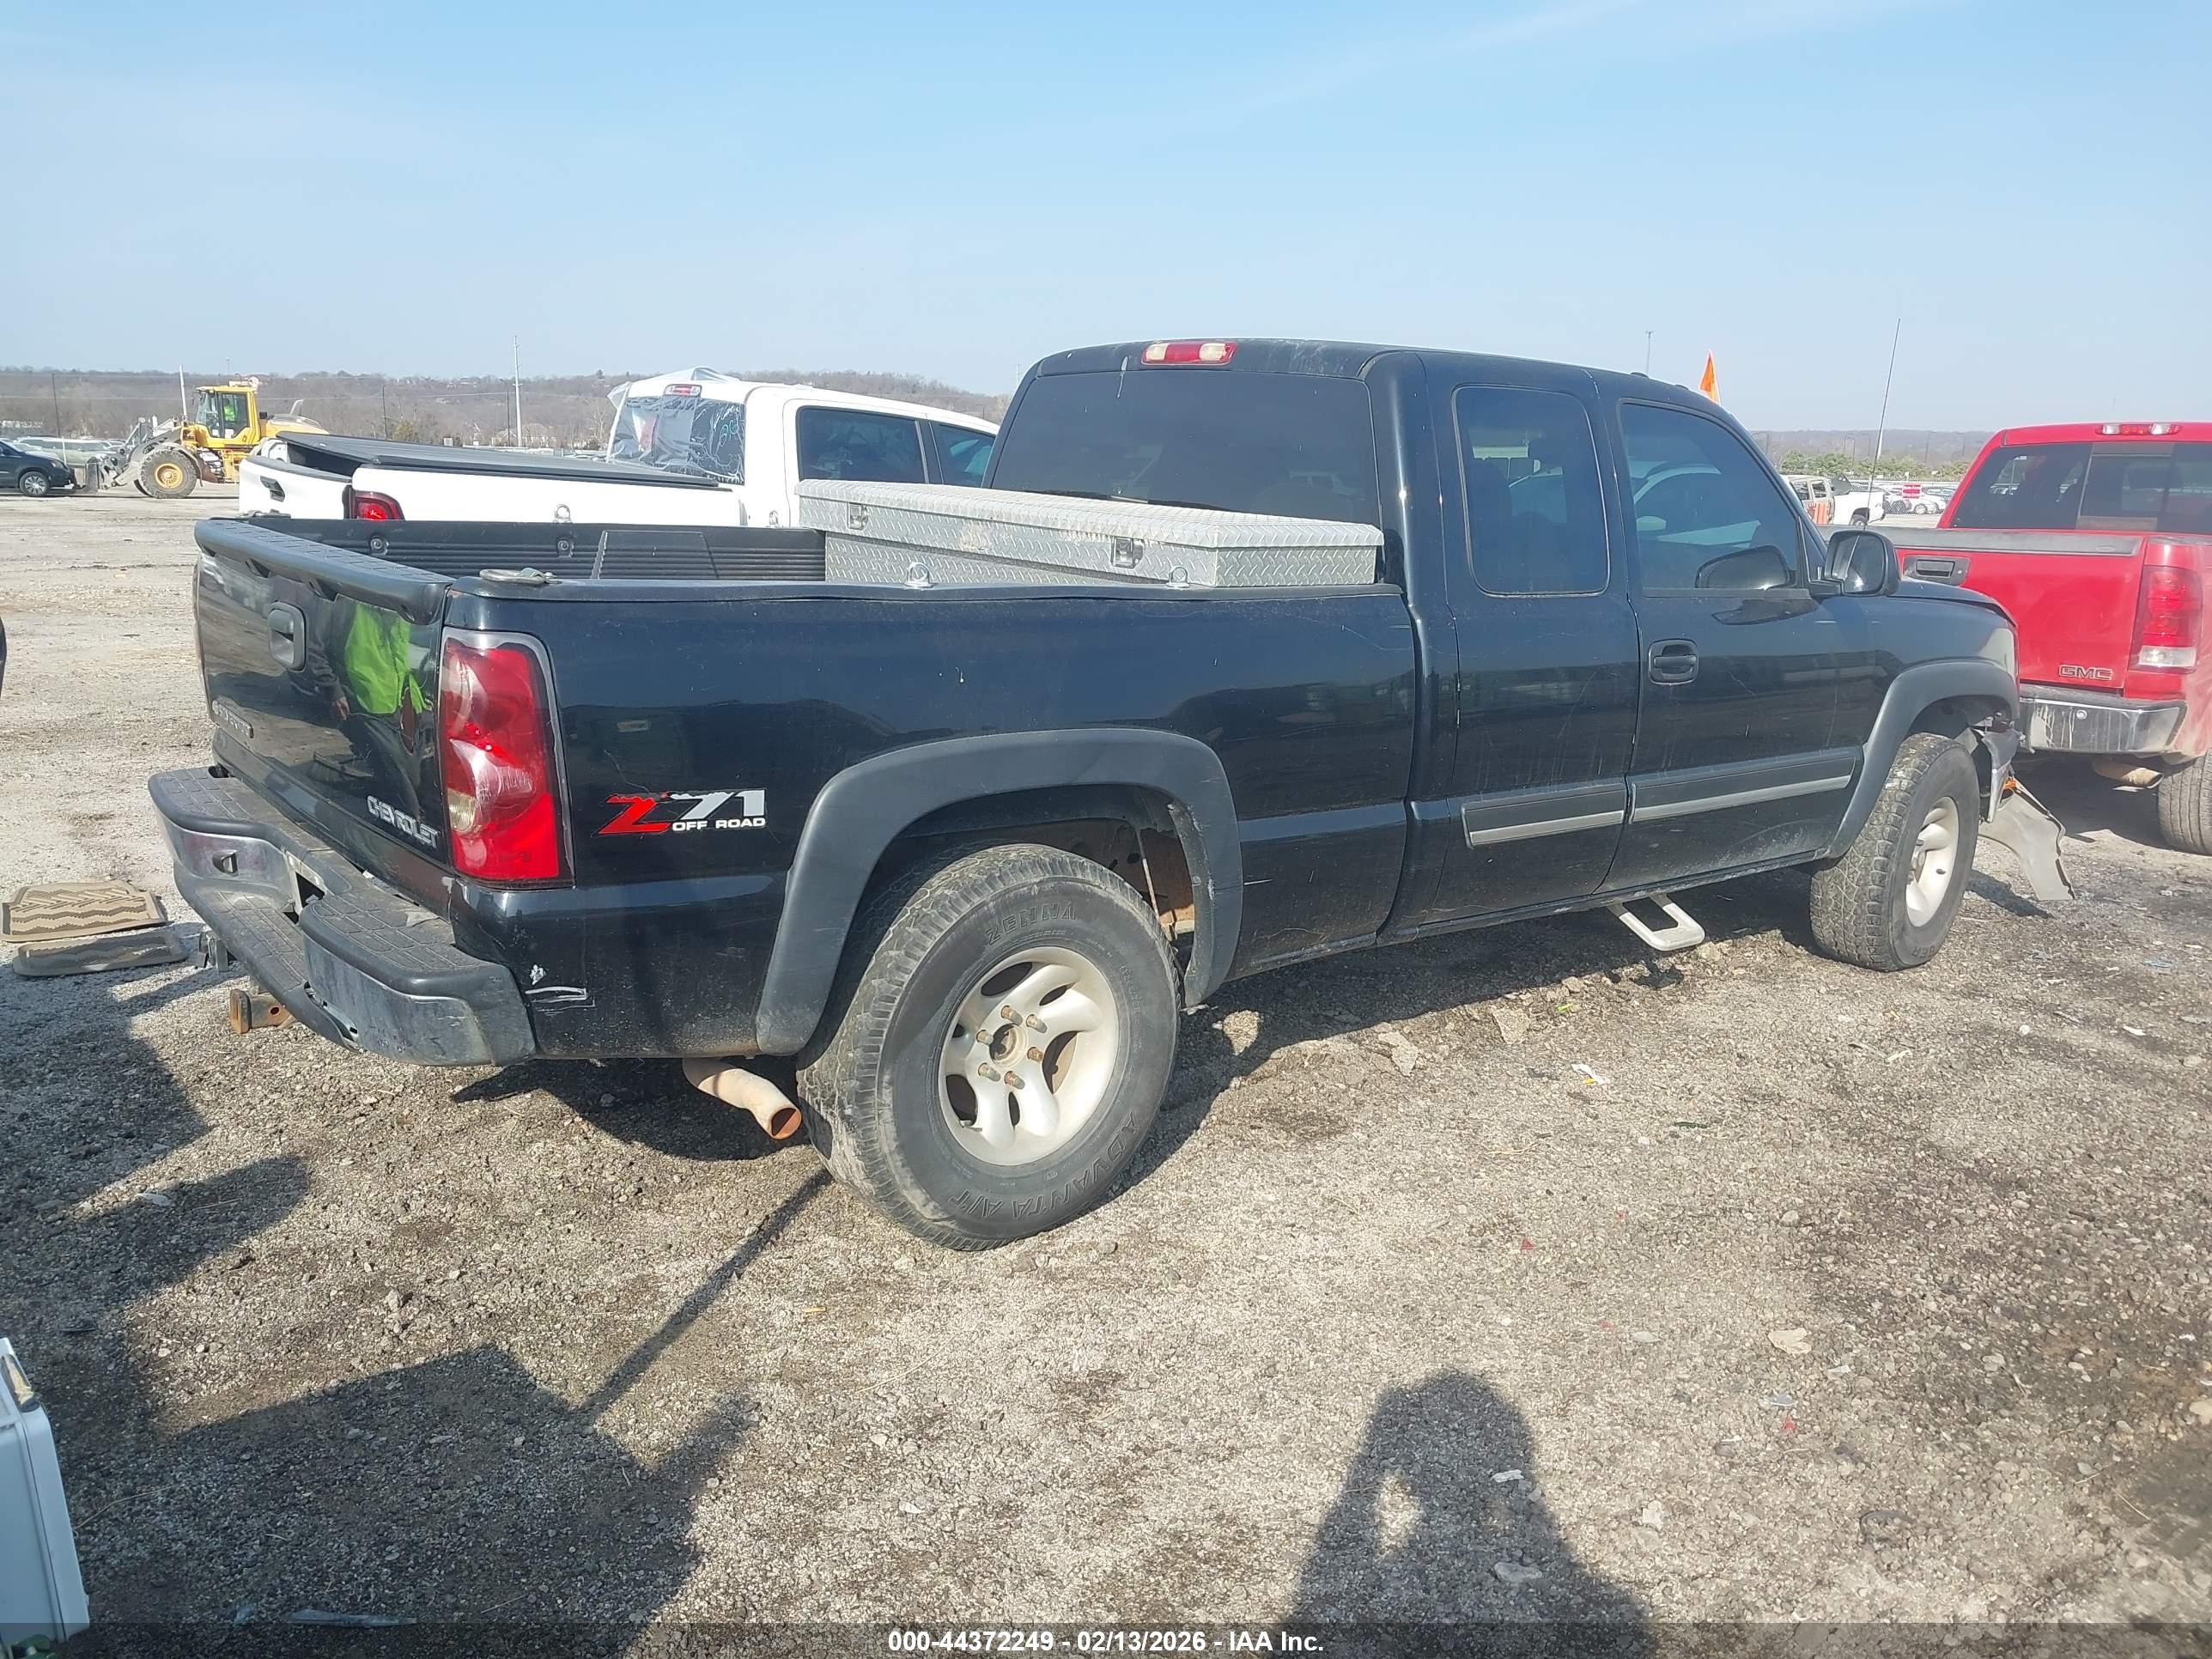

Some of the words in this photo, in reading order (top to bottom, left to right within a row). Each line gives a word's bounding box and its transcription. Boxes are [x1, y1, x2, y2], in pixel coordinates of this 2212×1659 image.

[2058, 665, 2113, 681] GMC
[367, 795, 440, 849] CHEVROLET
[598, 789, 765, 836] Z71
[672, 821, 708, 832] OFF
[715, 817, 766, 830] ROAD
[985, 902, 1077, 945] ZENNA
[1012, 1110, 1138, 1219] ADVANTA
